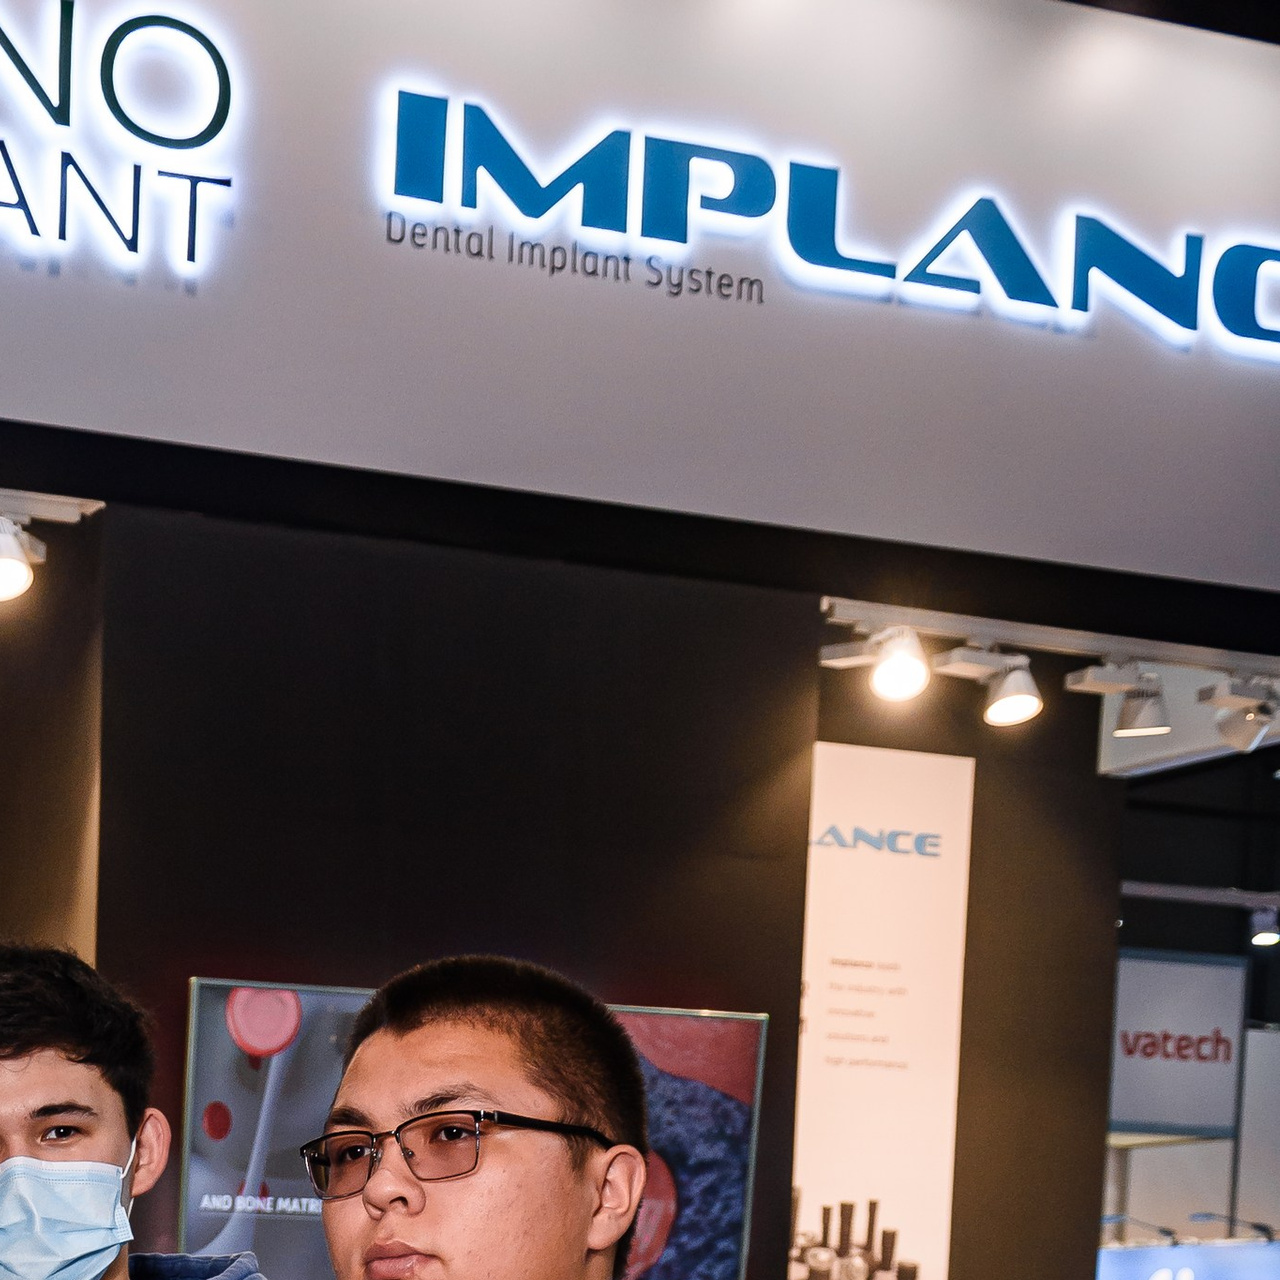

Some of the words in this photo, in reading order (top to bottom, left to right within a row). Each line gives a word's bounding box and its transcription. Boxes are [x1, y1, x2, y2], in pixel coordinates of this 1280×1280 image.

[386, 211, 494, 260] Dental
[507, 233, 631, 285] Implant
[646, 256, 765, 304] System
[808, 825, 942, 857] ANCE
[1122, 1027, 1231, 1064] vatech
[200, 1194, 233, 1211] AND
